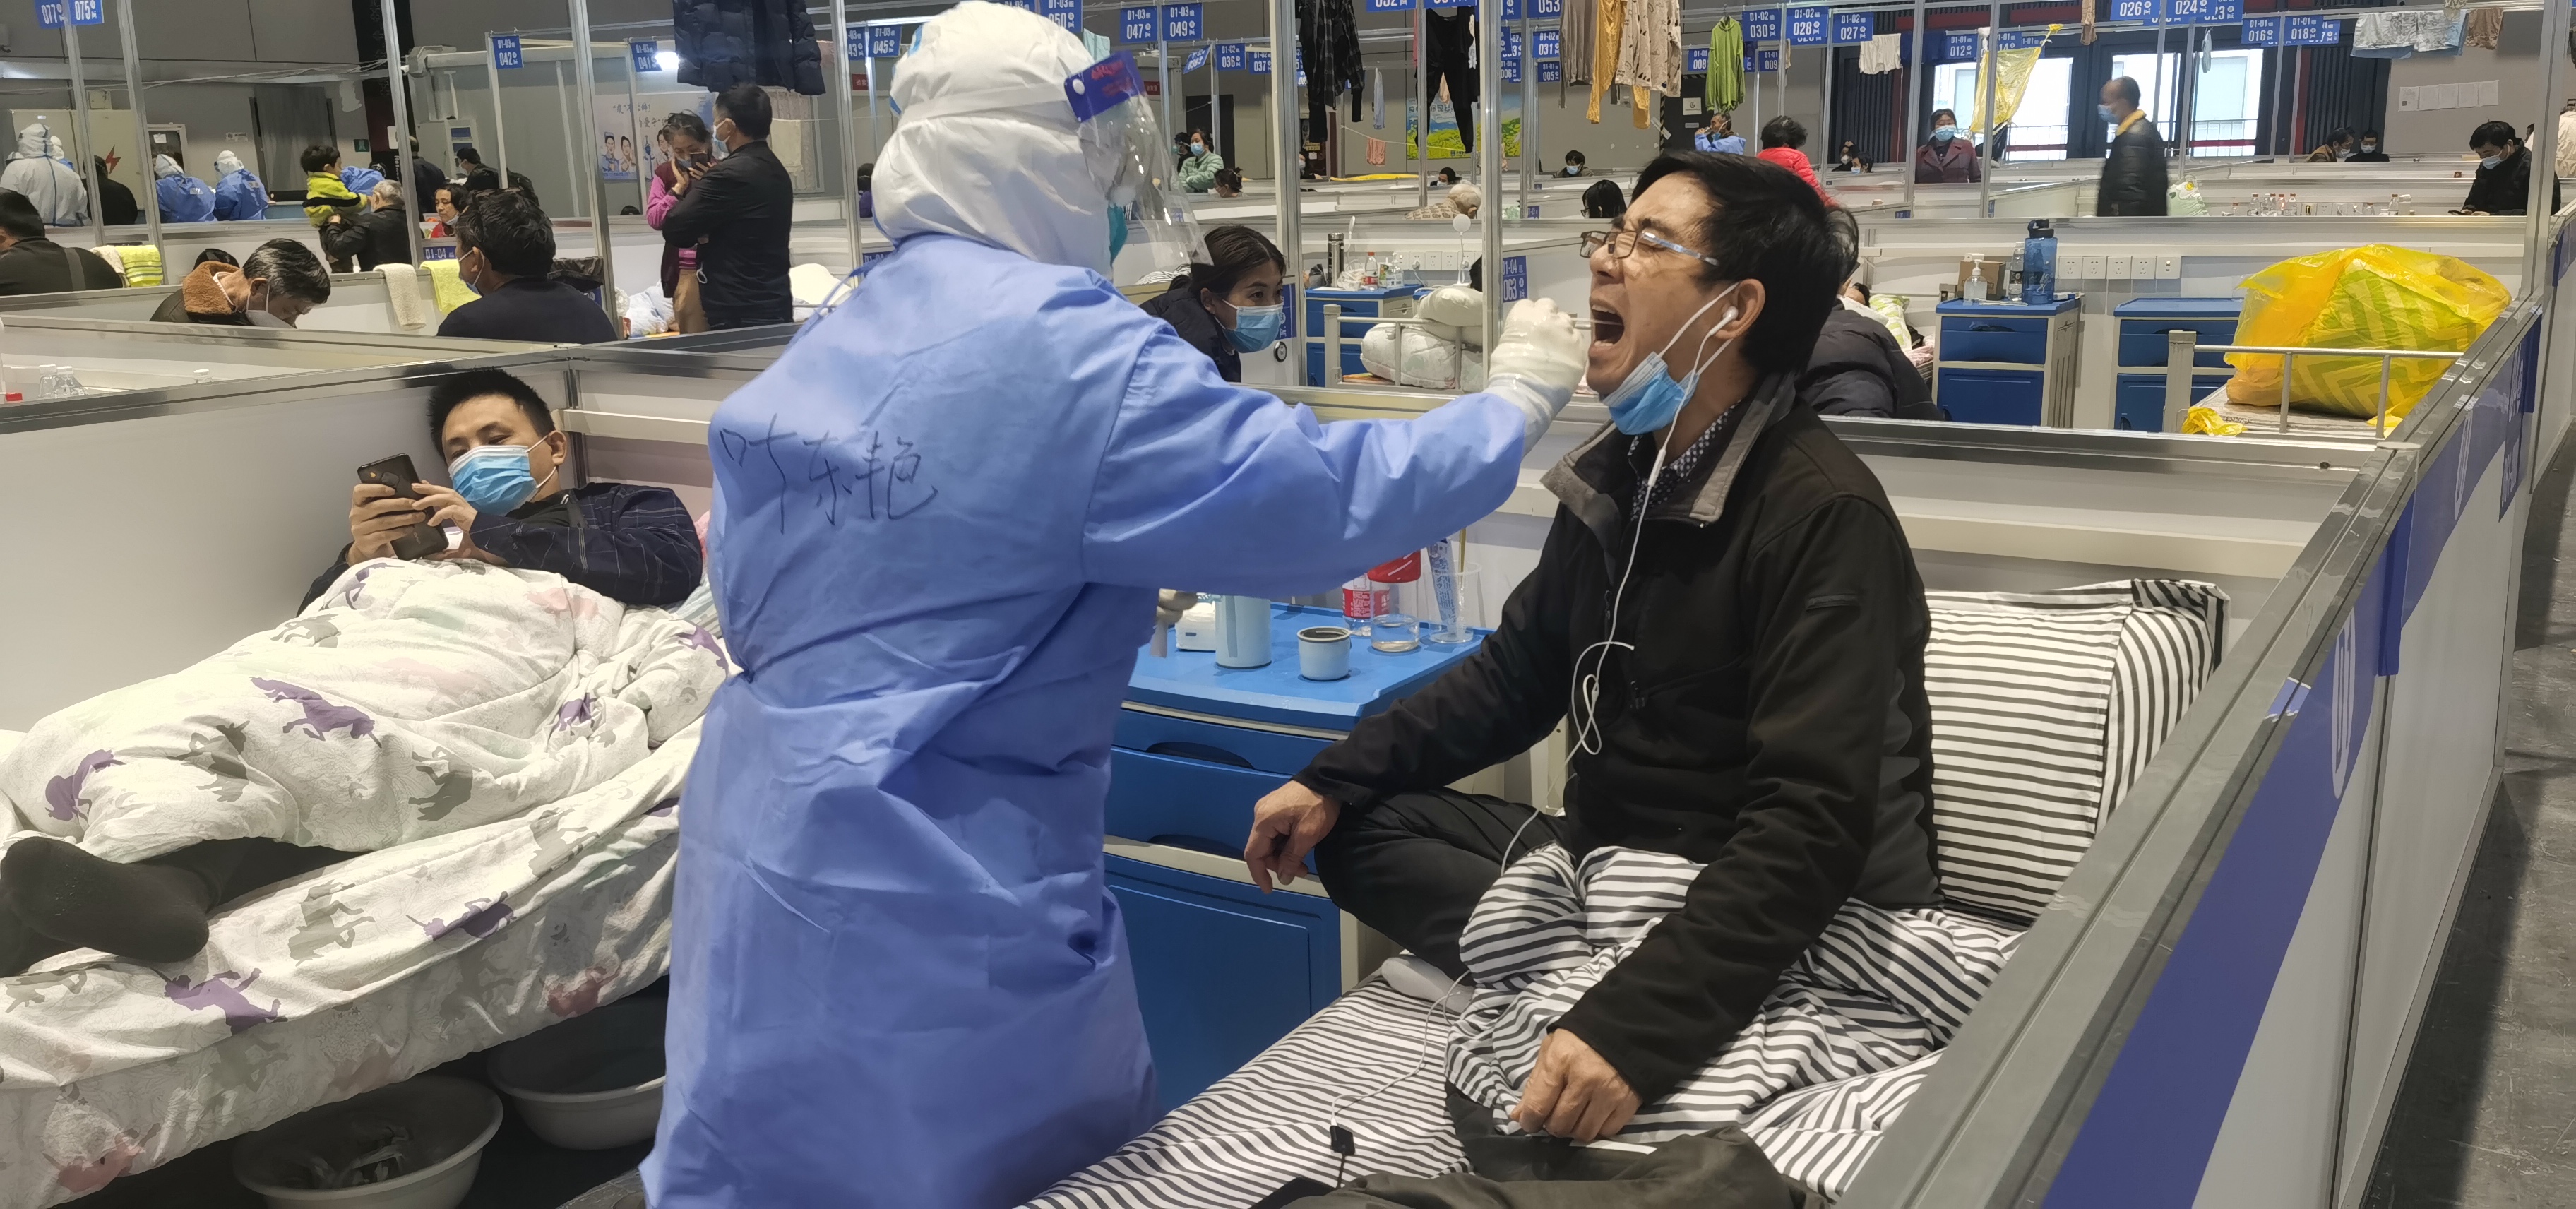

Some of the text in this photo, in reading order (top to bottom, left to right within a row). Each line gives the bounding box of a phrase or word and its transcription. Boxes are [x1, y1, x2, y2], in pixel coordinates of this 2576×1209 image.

[41, 4, 58, 24] 077
[74, 1, 91, 20] 075
[2120, 2, 2142, 17] 026
[2175, 0, 2198, 15] 024
[1126, 23, 1144, 40] 047
[1169, 20, 1188, 37] 049
[1750, 24, 1768, 38] 030
[1793, 21, 1812, 35] 028
[1840, 26, 1859, 40] 027
[2291, 28, 2309, 40] 018
[2248, 30, 2266, 42] 016
[848, 43, 858, 56] 43
[873, 40, 889, 54] 045
[1538, 43, 1554, 56] 031
[1950, 45, 1965, 57] 012
[499, 52, 513, 66] 042
[638, 56, 651, 69] 041
[1222, 56, 1236, 69] 036
[1693, 59, 1707, 69] 008
[1765, 60, 1778, 70] 009
[1253, 60, 1267, 73] 037
[1542, 71, 1555, 81] 005
[1503, 278, 1517, 301] 063
